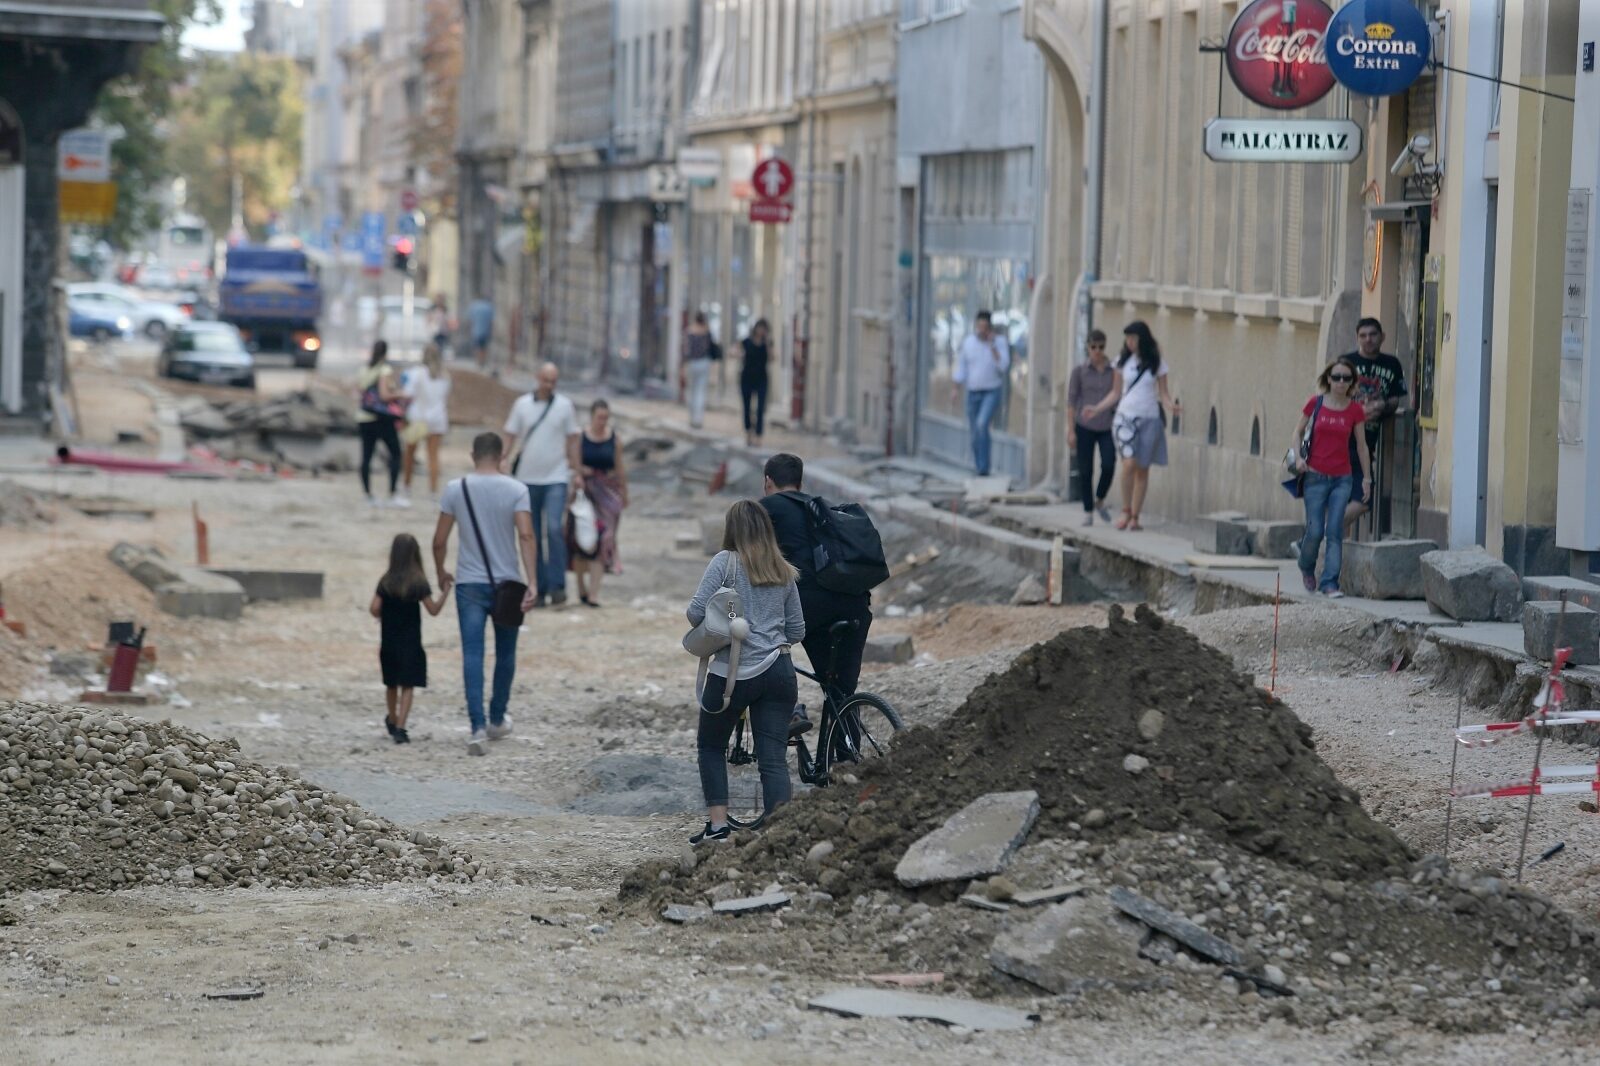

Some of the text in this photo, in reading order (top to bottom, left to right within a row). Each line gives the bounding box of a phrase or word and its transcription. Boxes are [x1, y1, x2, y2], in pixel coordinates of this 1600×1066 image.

[1235, 27, 1326, 64] Coca-Cola
[1336, 35, 1417, 56] Corona
[1354, 56, 1400, 71] Extra
[1238, 132, 1349, 150] ALCATRAZ
